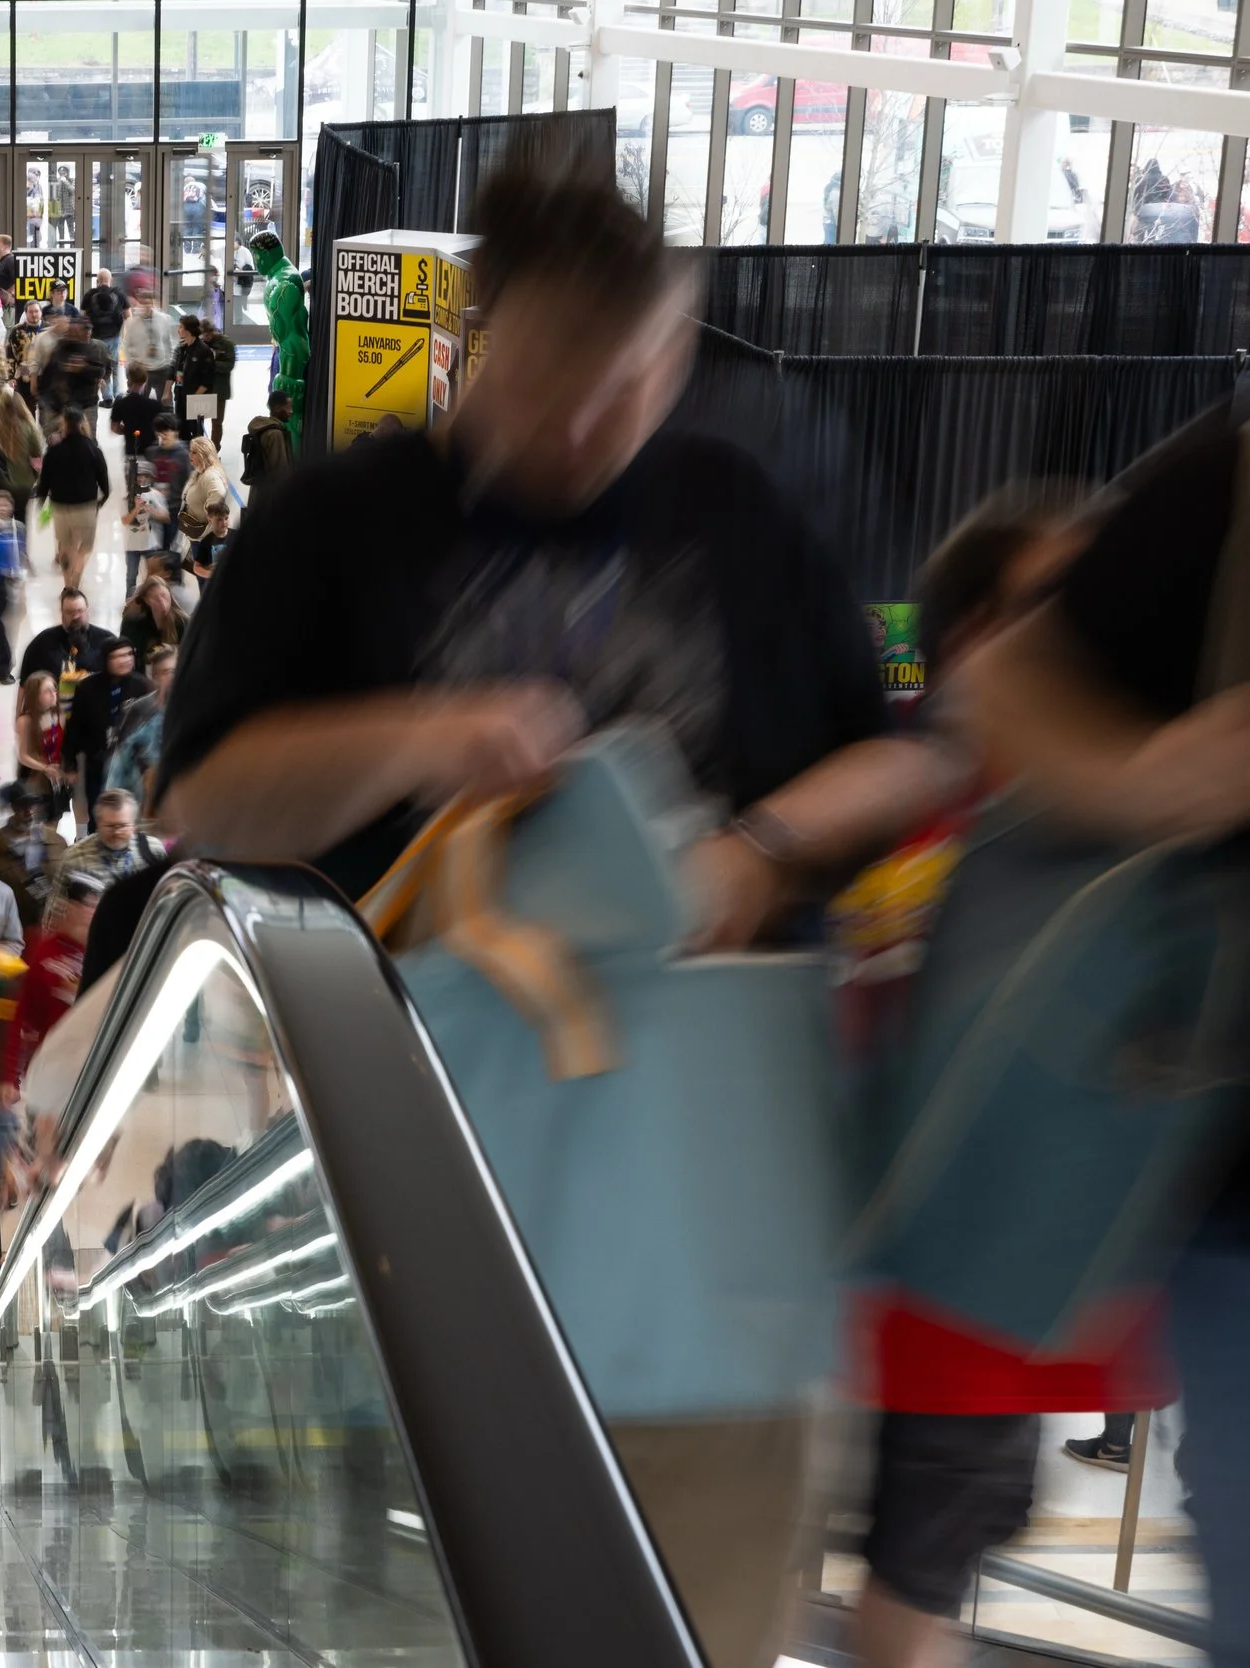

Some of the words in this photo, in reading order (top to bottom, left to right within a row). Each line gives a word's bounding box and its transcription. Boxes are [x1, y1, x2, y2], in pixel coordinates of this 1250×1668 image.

[16, 256, 54, 277] THIS
[59, 256, 74, 277] IS
[338, 252, 398, 273] OFFICIAL
[16, 278, 55, 299] LEVE
[68, 279, 74, 299] 1
[338, 272, 398, 295] MERCH
[437, 257, 475, 315] LEXING
[337, 294, 398, 319] BOOTH
[358, 336, 401, 351] LANYARDS
[468, 329, 490, 354] GE
[358, 351, 382, 364] $5.00
[434, 340, 449, 370] CASH
[432, 376, 446, 407] ONLY
